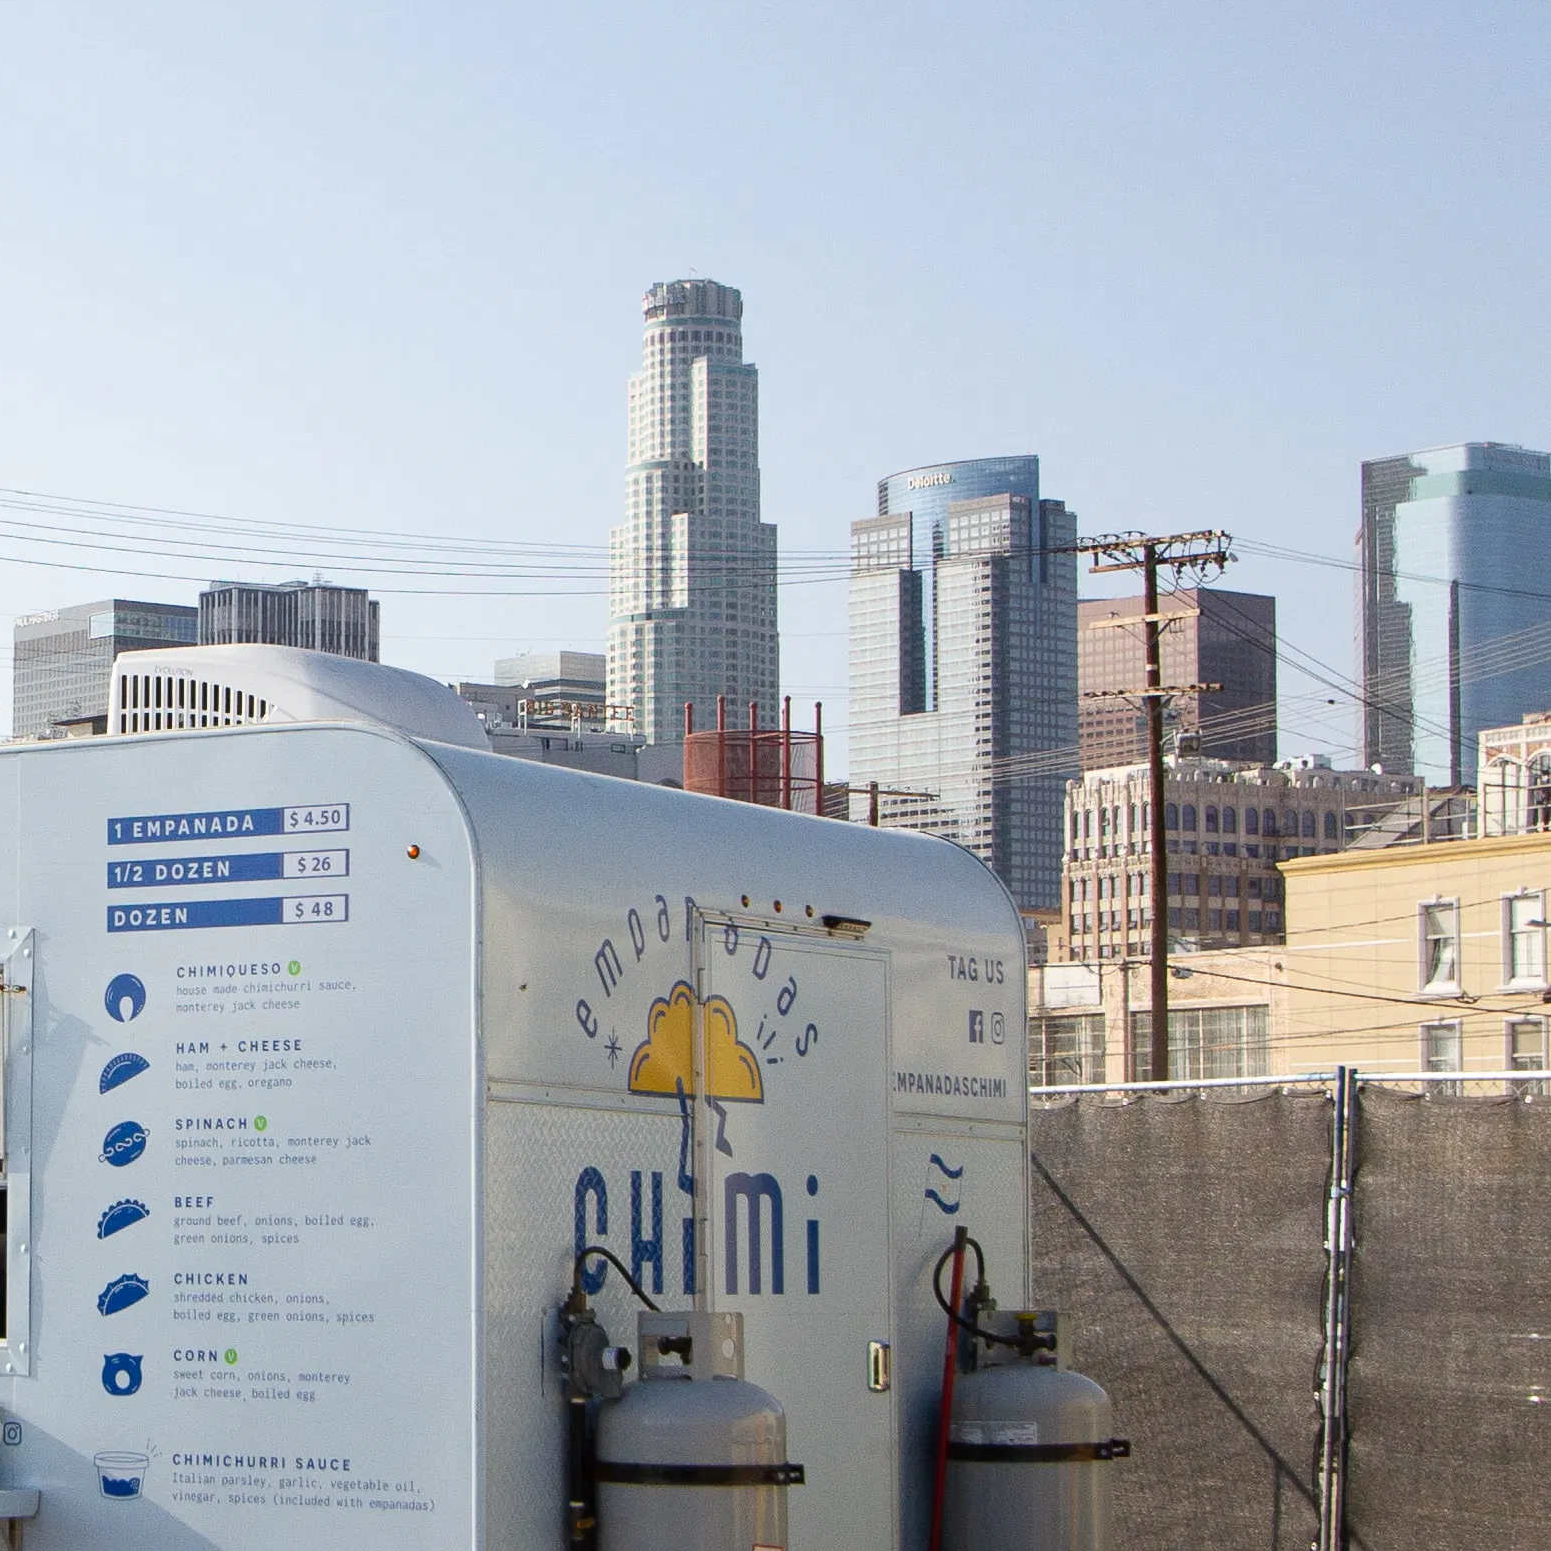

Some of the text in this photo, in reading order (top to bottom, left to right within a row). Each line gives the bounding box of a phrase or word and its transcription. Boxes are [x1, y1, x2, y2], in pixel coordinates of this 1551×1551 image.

[114, 822, 122, 839] 1
[132, 814, 255, 838] EMPANADA
[303, 809, 341, 826] 4.50
[114, 863, 144, 883] 1/2
[155, 860, 230, 881] DOZEN
[311, 856, 331, 872] 26
[114, 907, 188, 927] DOZEN
[311, 901, 333, 918] 48
[176, 962, 281, 979] CHIMIQUESO
[947, 955, 1005, 985] TAG US
[175, 980, 356, 997] house made chimichurri sauce,
[175, 998, 300, 1014] monterey jack cheese
[175, 1038, 301, 1055] HAM + CHEESE
[175, 1057, 336, 1074] ham, monterey jack cheese,
[174, 1076, 292, 1091] boiled egg, oregano
[893, 1071, 1006, 1098] MPANADASCHIMI
[174, 1117, 247, 1132] SPINACH
[174, 1134, 371, 1151] spinach, ricotta, monterey jack
[174, 1153, 317, 1168] cheese, parmesan cheese
[174, 1195, 213, 1209] BEEF
[173, 1213, 374, 1229] ground beef, onions, boiled egg,
[173, 1232, 299, 1246] green onions, spices
[173, 1272, 247, 1286] CHICKEN
[173, 1291, 329, 1306] shredded chicken, onions,
[172, 1308, 374, 1327] boiled egg, green onions, spices
[172, 1349, 217, 1363] CORN
[172, 1369, 350, 1386] sweet corn, onions, monterey
[173, 1386, 316, 1404] jack cheese, boiled egg
[172, 1452, 350, 1472] CHIMICHURRI SAUCE
[172, 1471, 420, 1494] Italian parsley, garlic, vegetable oil,
[171, 1490, 434, 1513] vinegar, spices (included with empanadas)
